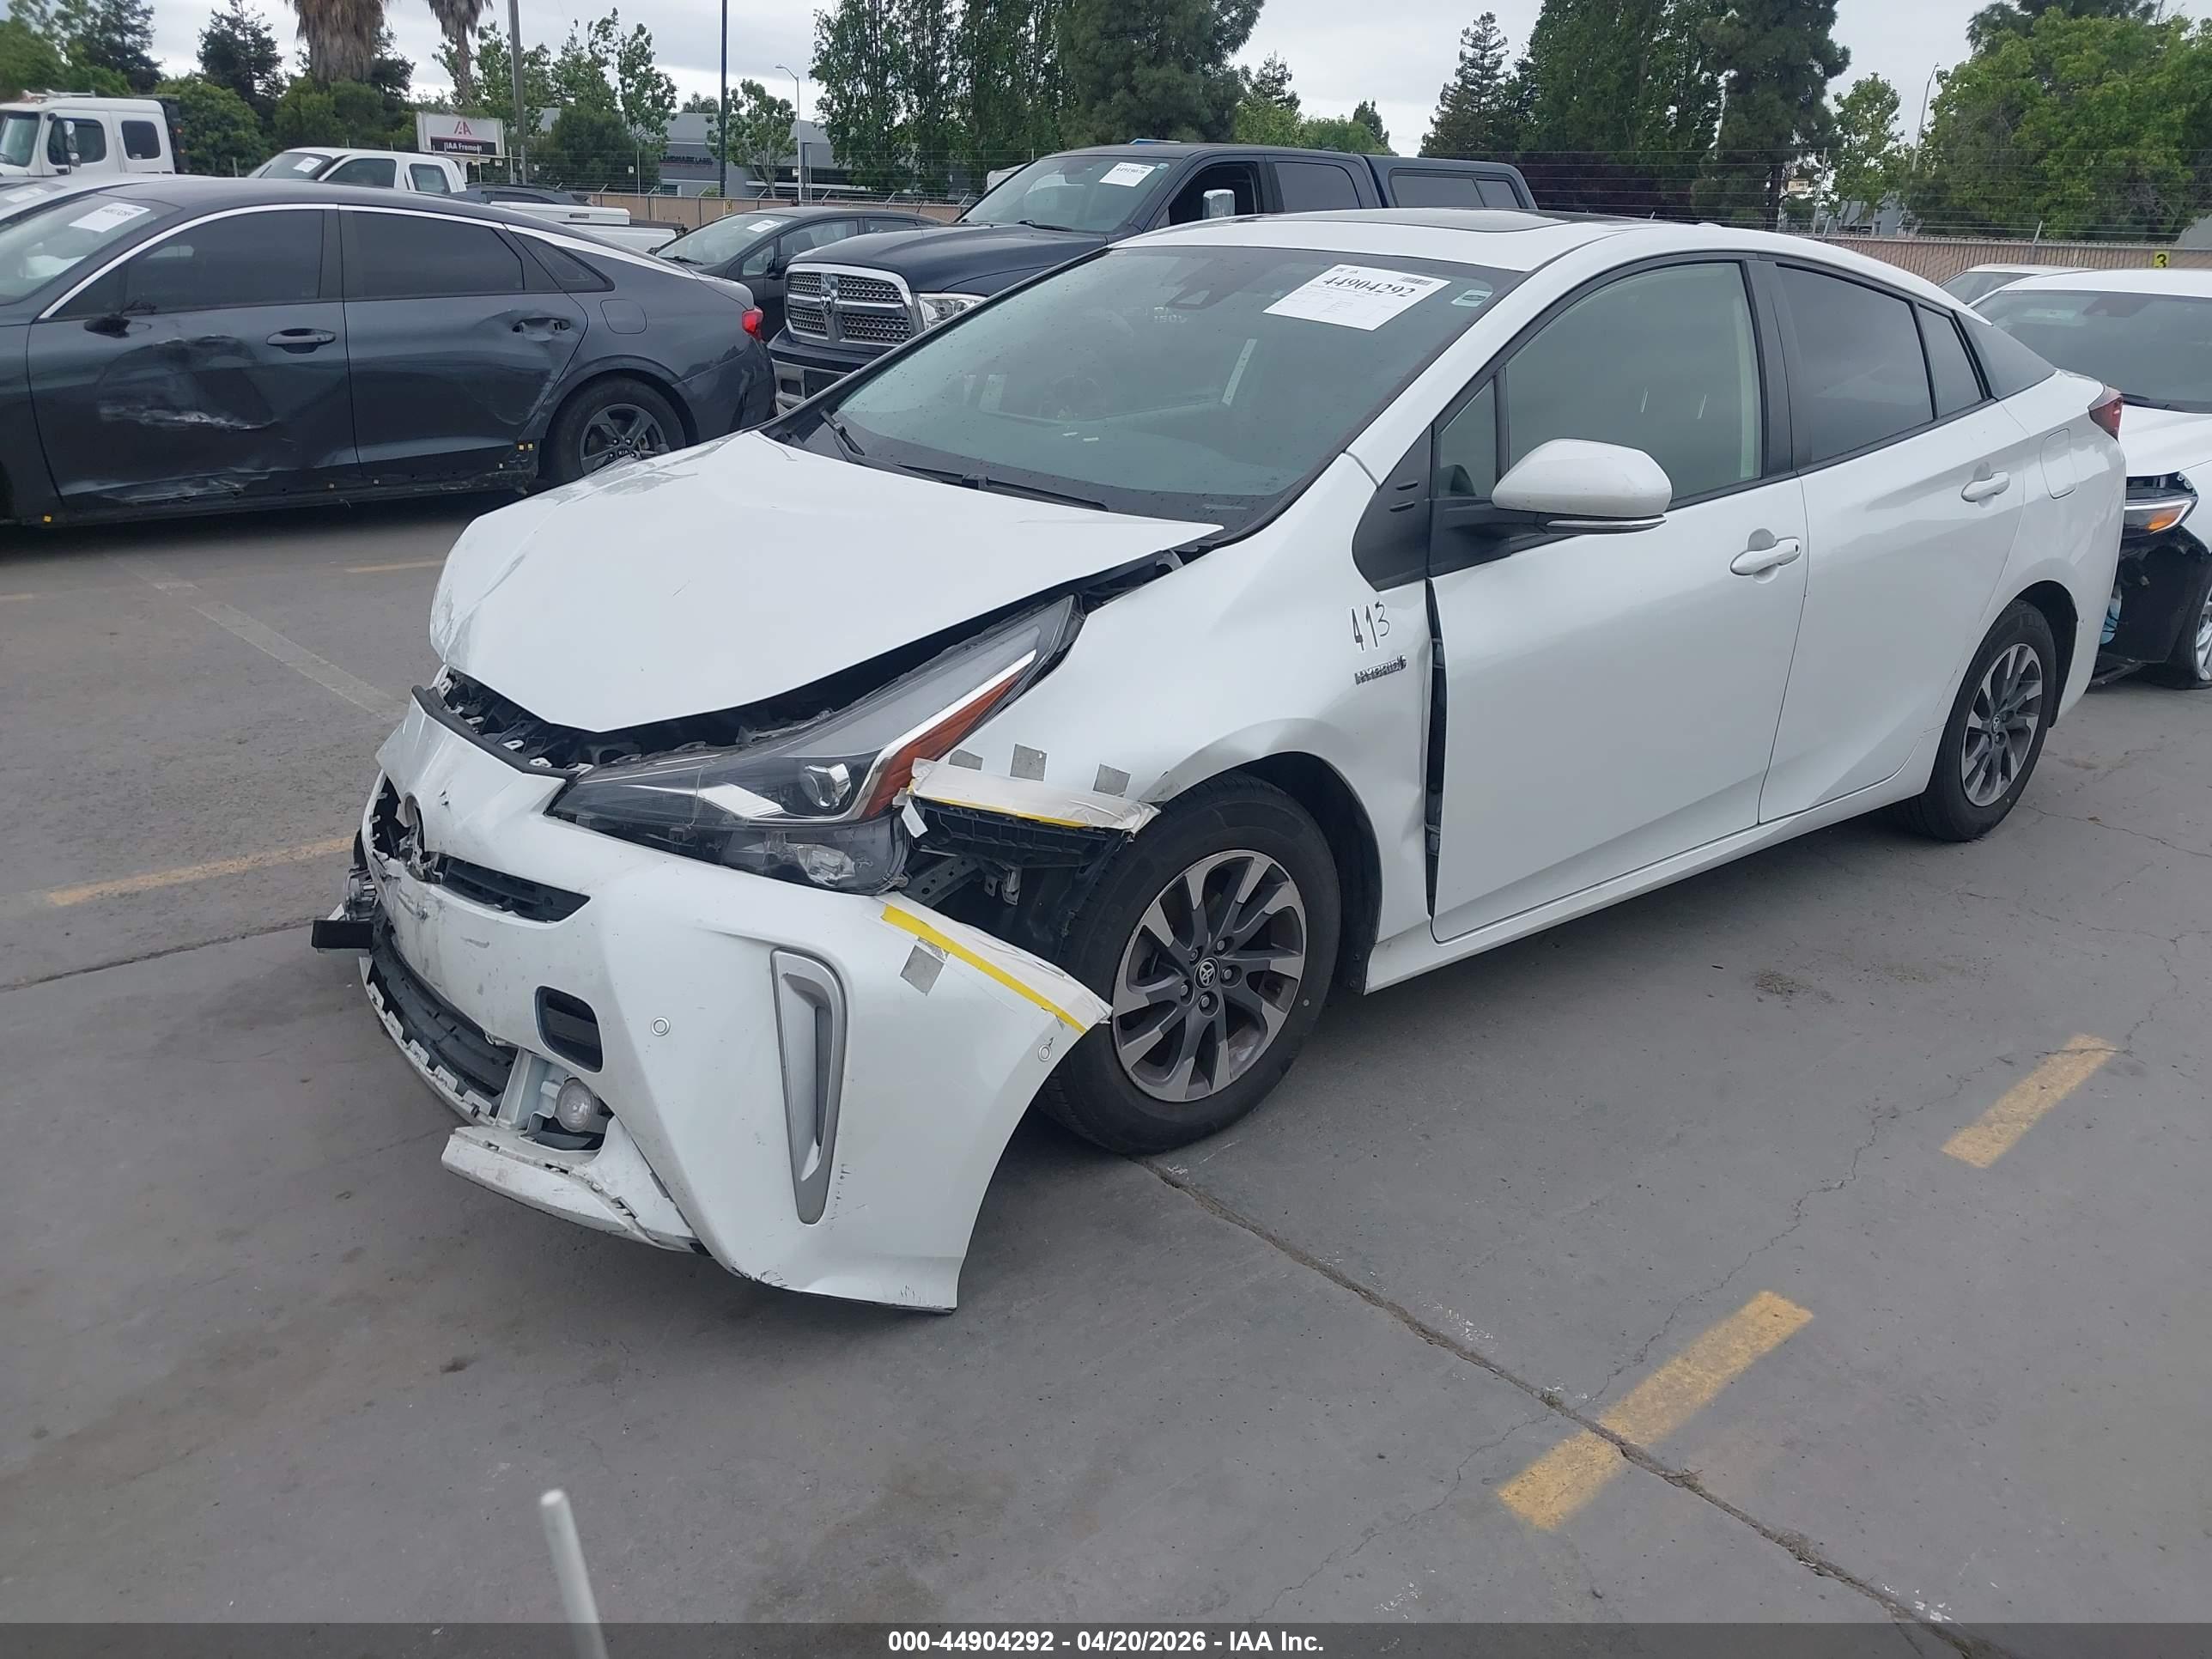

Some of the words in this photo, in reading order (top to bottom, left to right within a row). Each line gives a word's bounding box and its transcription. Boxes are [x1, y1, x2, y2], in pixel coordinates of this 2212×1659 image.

[446, 142, 458, 150] IAA
[2155, 253, 2166, 268] 3
[1322, 275, 1416, 297] 44904292
